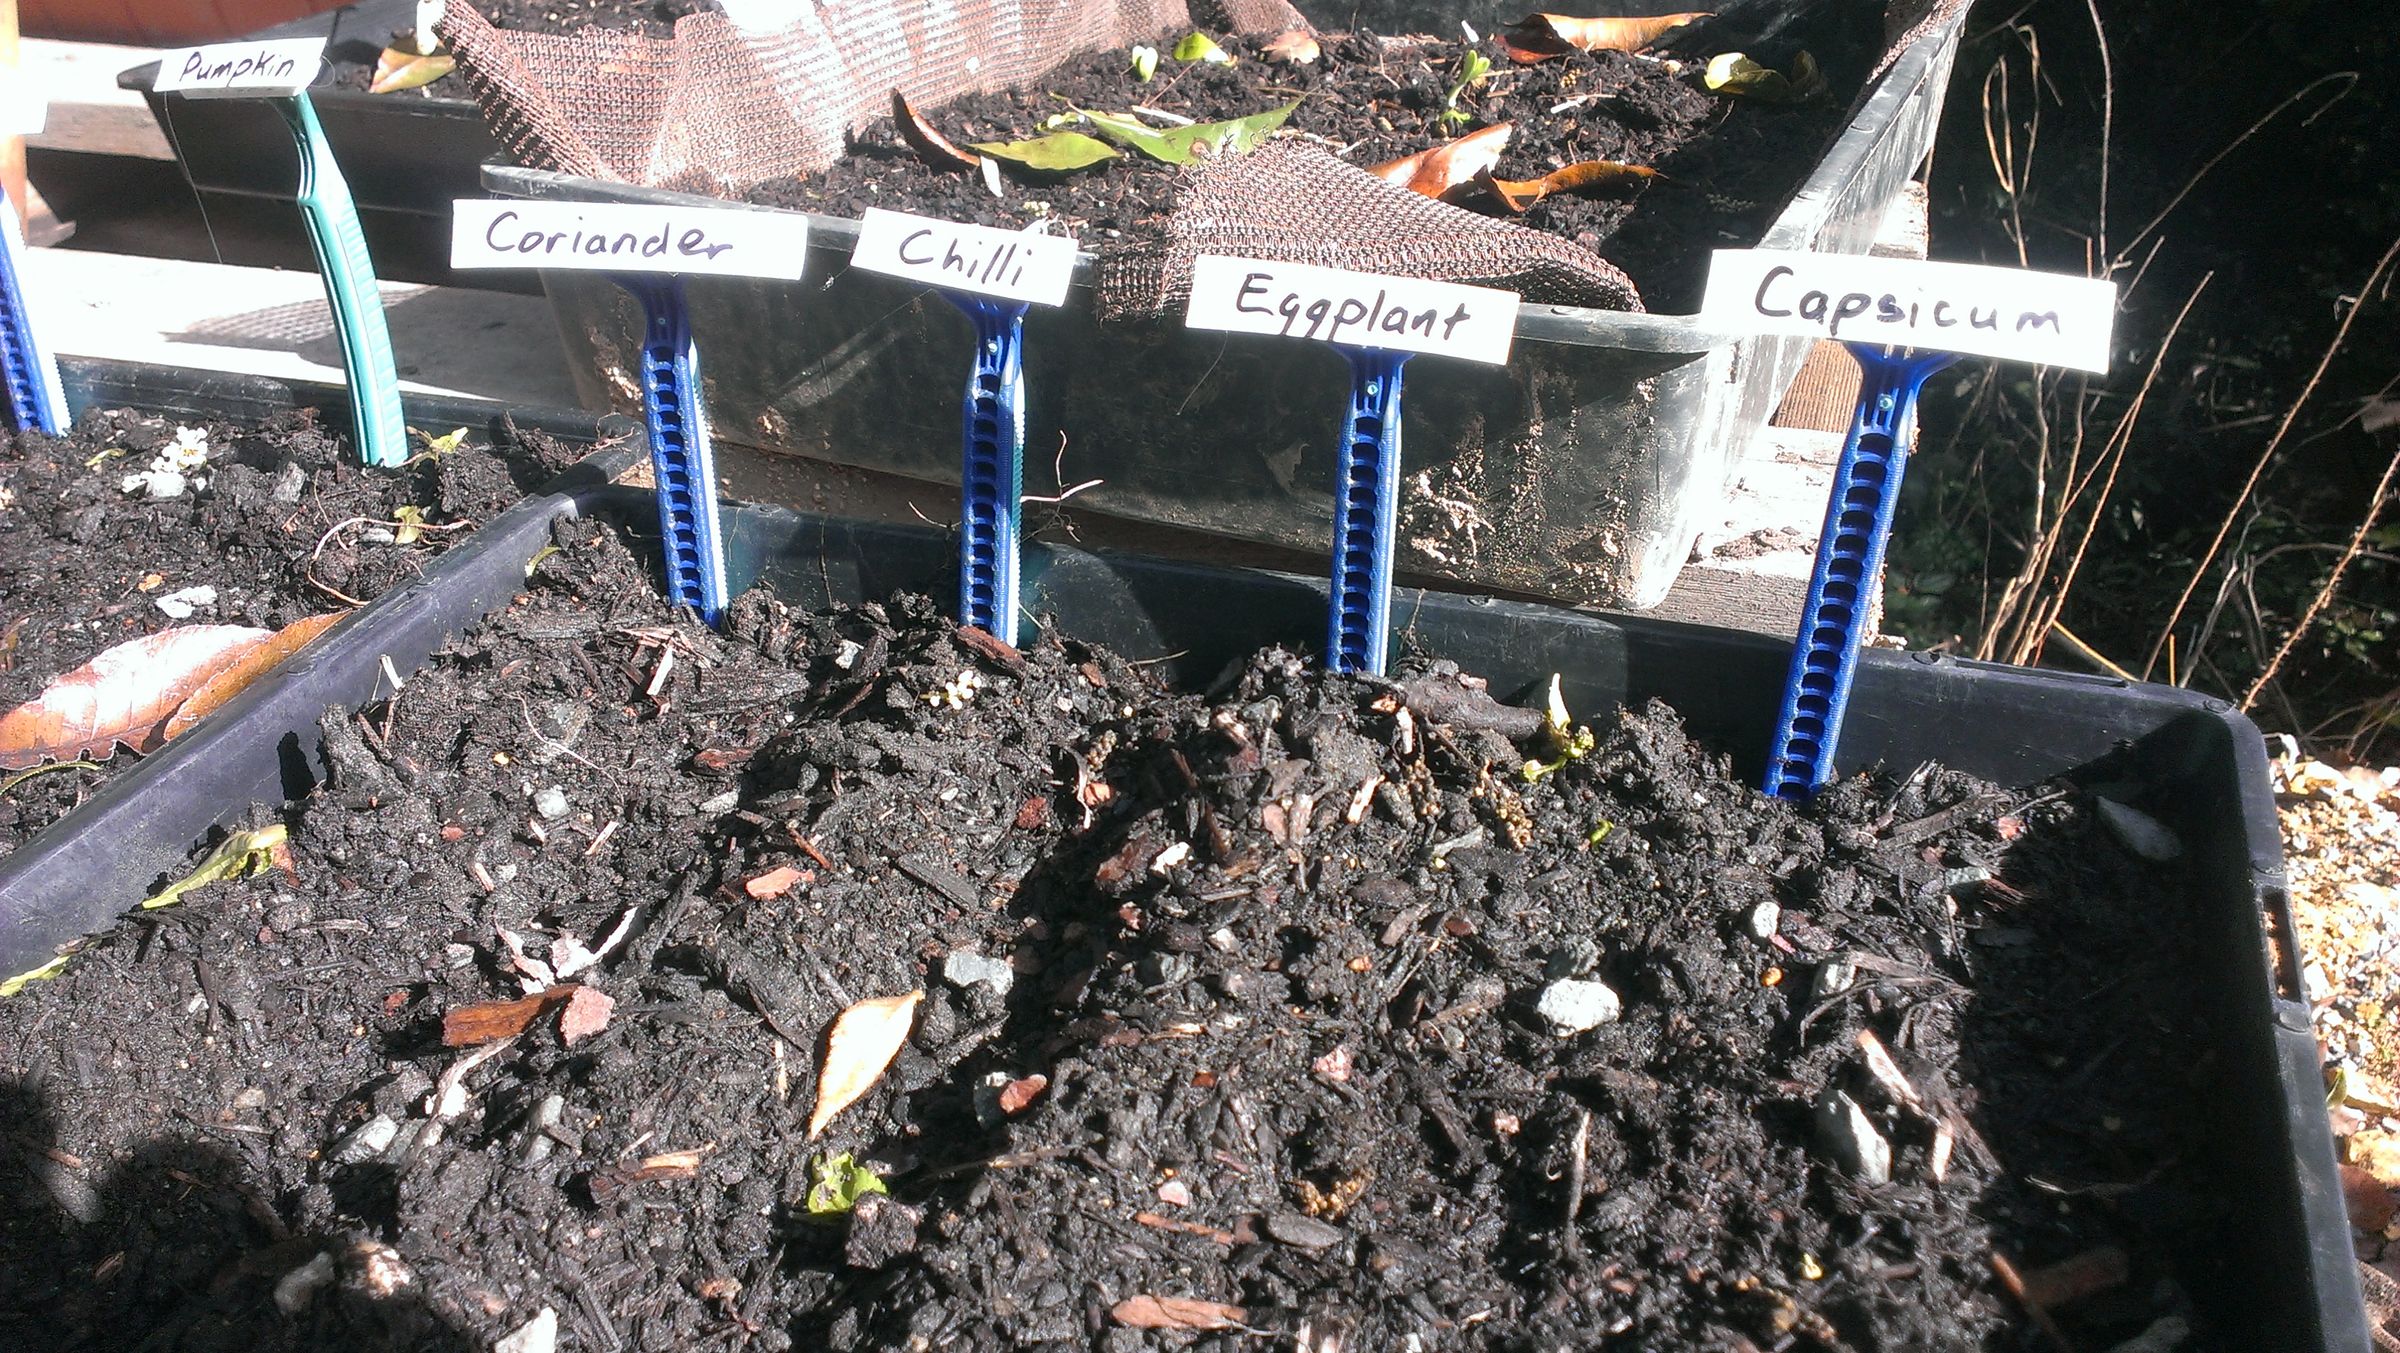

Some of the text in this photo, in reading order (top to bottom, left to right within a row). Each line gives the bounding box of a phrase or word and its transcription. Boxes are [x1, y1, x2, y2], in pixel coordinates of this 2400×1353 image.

[180, 51, 295, 86] Pumpkin
[487, 211, 733, 258] Coriander
[899, 229, 1032, 286] Chilli
[1236, 273, 1471, 341] Eggplant
[1754, 266, 2060, 337] Capsicum
